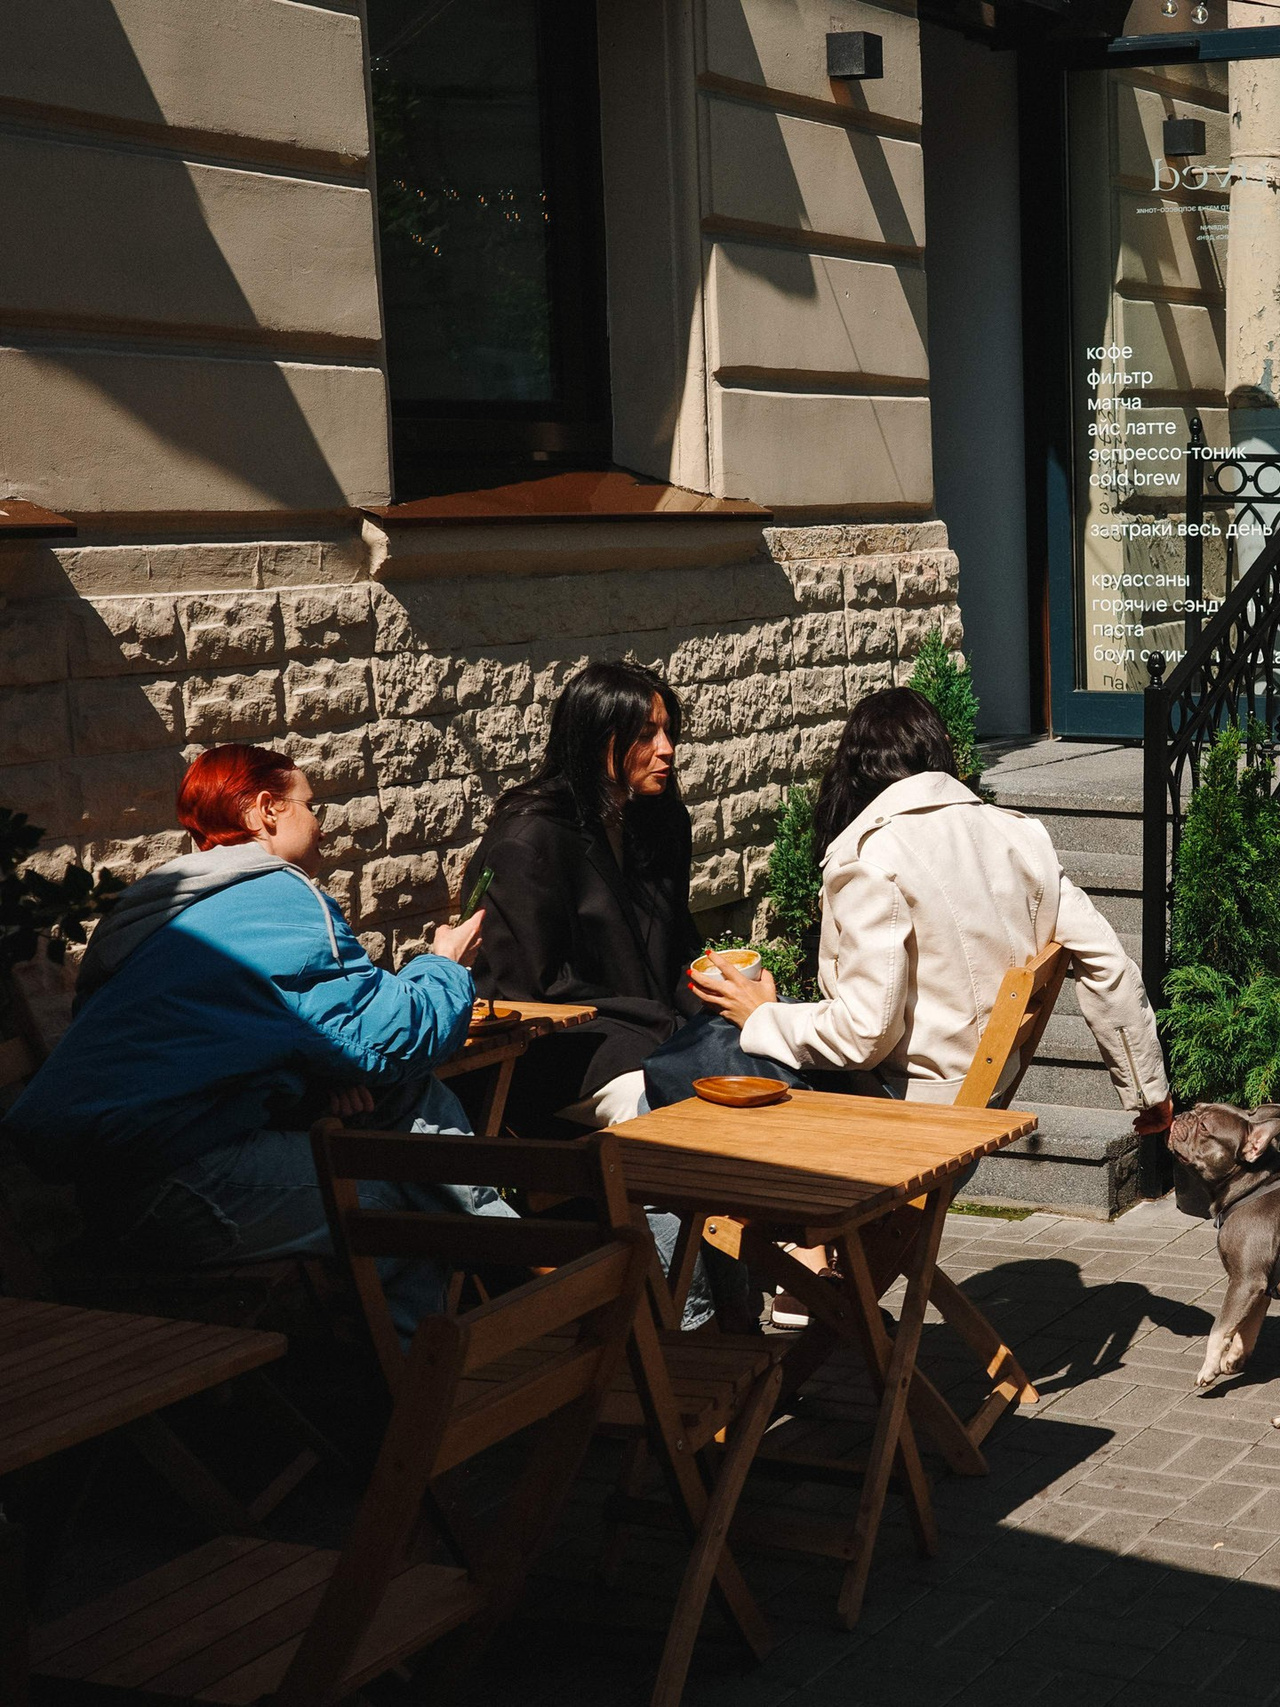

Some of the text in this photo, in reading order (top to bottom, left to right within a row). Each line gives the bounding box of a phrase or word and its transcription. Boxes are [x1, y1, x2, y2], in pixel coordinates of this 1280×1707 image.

[1086, 342, 1133, 363] кофе
[1087, 368, 1154, 389] фильтр
[1087, 397, 1142, 411] матча
[1088, 420, 1177, 436] айс латте
[1088, 446, 1247, 465] эспрессо-тоник
[1089, 470, 1181, 487] cold brew
[1091, 523, 1273, 542] завтраки весь день
[1092, 573, 1190, 591] круассаны
[1092, 599, 1236, 616] горячие сэнд
[1093, 624, 1144, 638] паста
[1093, 645, 1135, 666] боул
